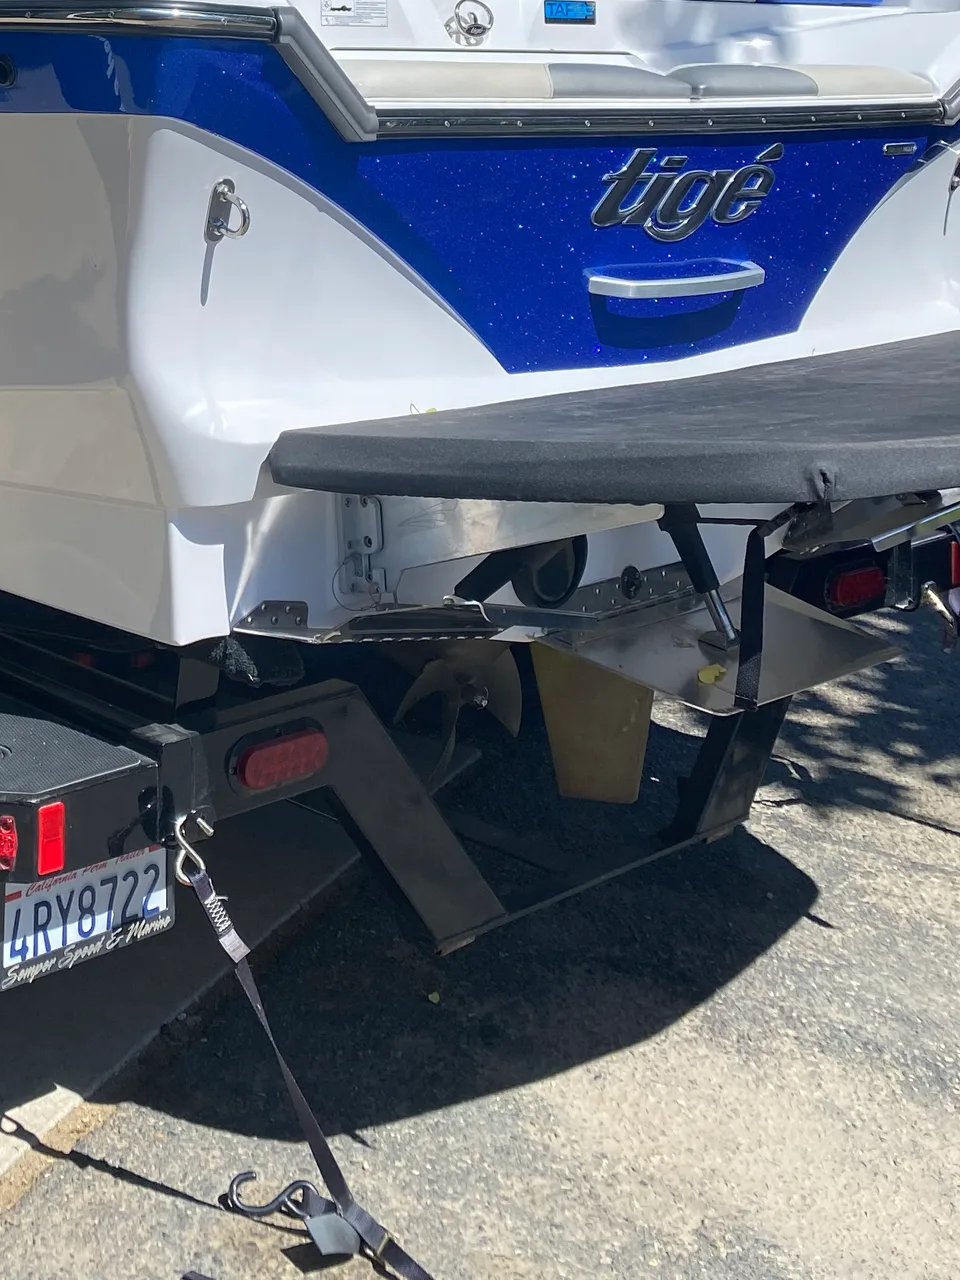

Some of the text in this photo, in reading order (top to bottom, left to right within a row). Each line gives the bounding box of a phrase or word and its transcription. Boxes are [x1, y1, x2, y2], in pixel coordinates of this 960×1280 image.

[591, 142, 785, 242] tigé
[9, 863, 161, 962] 4RY8722
[26, 871, 78, 898] California
[1, 957, 56, 990] Semper
[58, 935, 106, 970] Speed
[126, 915, 172, 943] Marine
